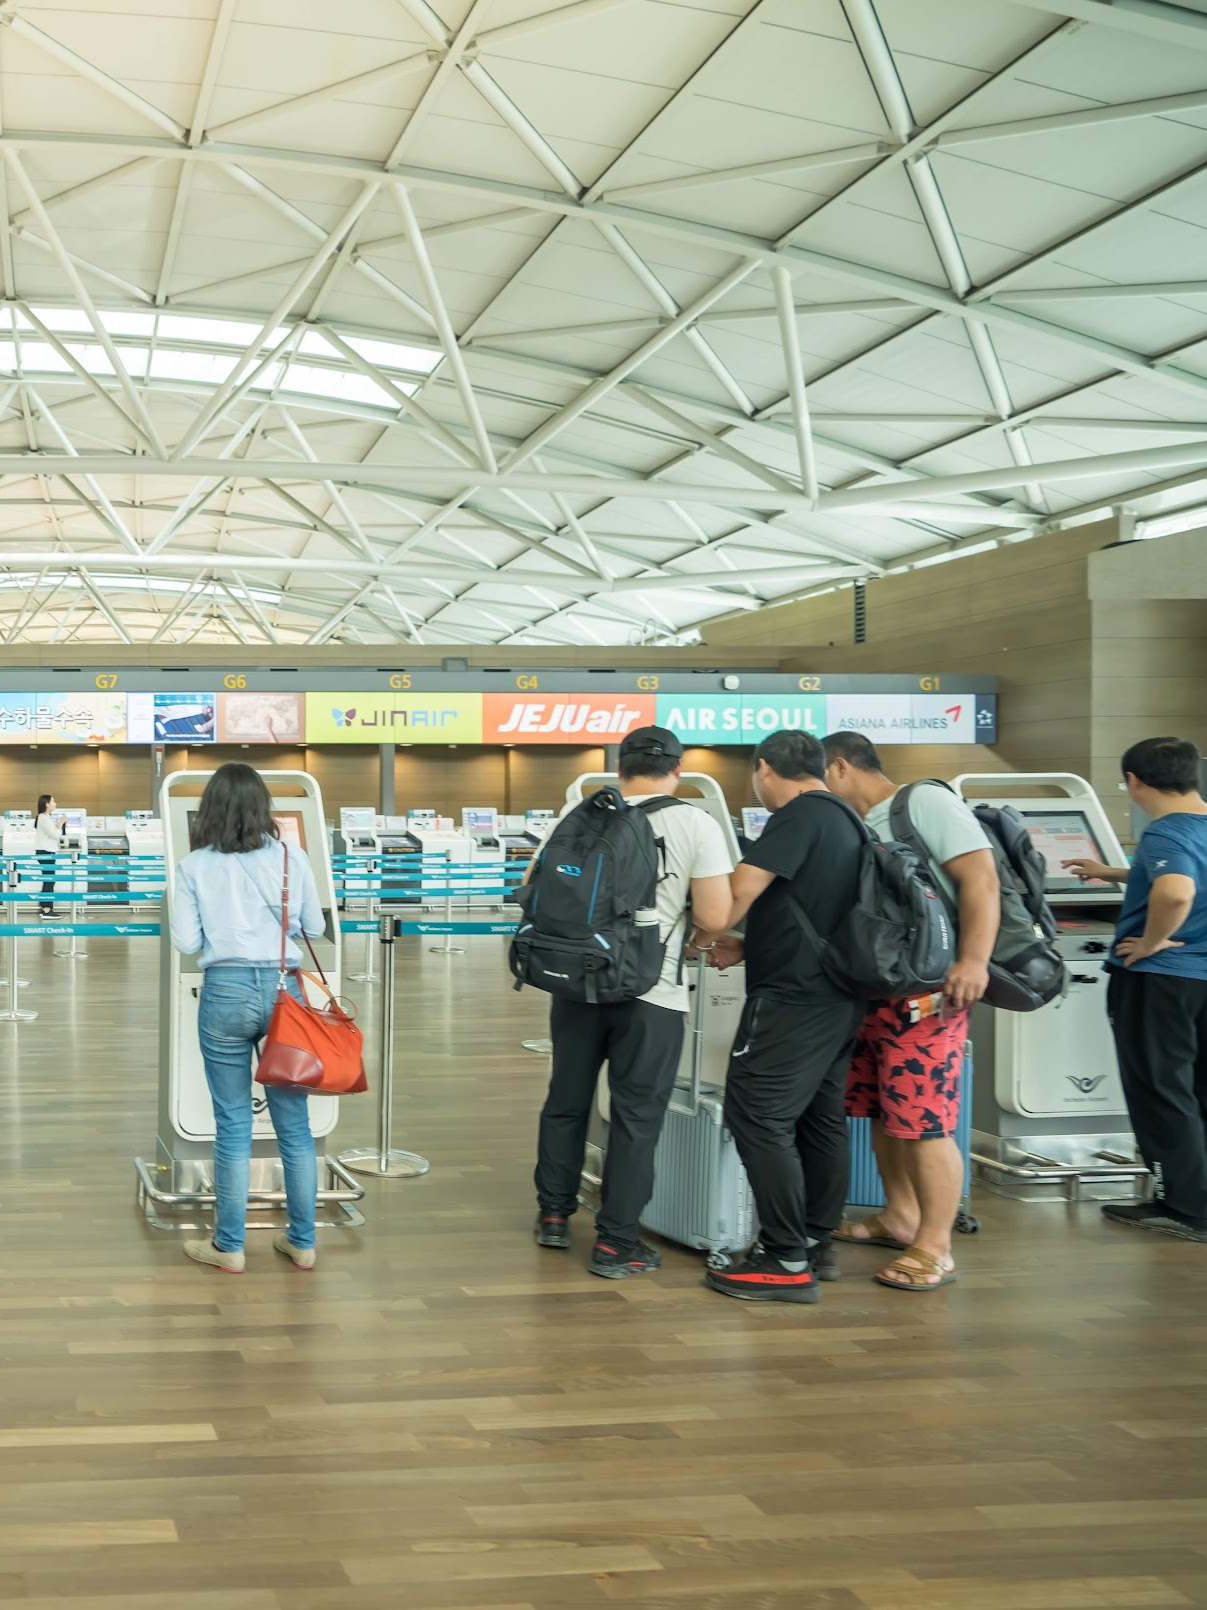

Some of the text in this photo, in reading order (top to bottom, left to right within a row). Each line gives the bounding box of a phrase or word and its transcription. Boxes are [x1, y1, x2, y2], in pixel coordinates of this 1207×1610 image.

[95, 674, 119, 689] G7
[223, 674, 247, 689] G6
[389, 674, 412, 689] G5
[516, 675, 539, 690] G4
[637, 676, 660, 690] G3
[798, 676, 821, 691] G2
[919, 676, 941, 691] G1
[497, 703, 641, 733] JEJUair
[664, 708, 818, 730] AIR SEOUL
[838, 717, 948, 730] ASIANA AIRLINES
